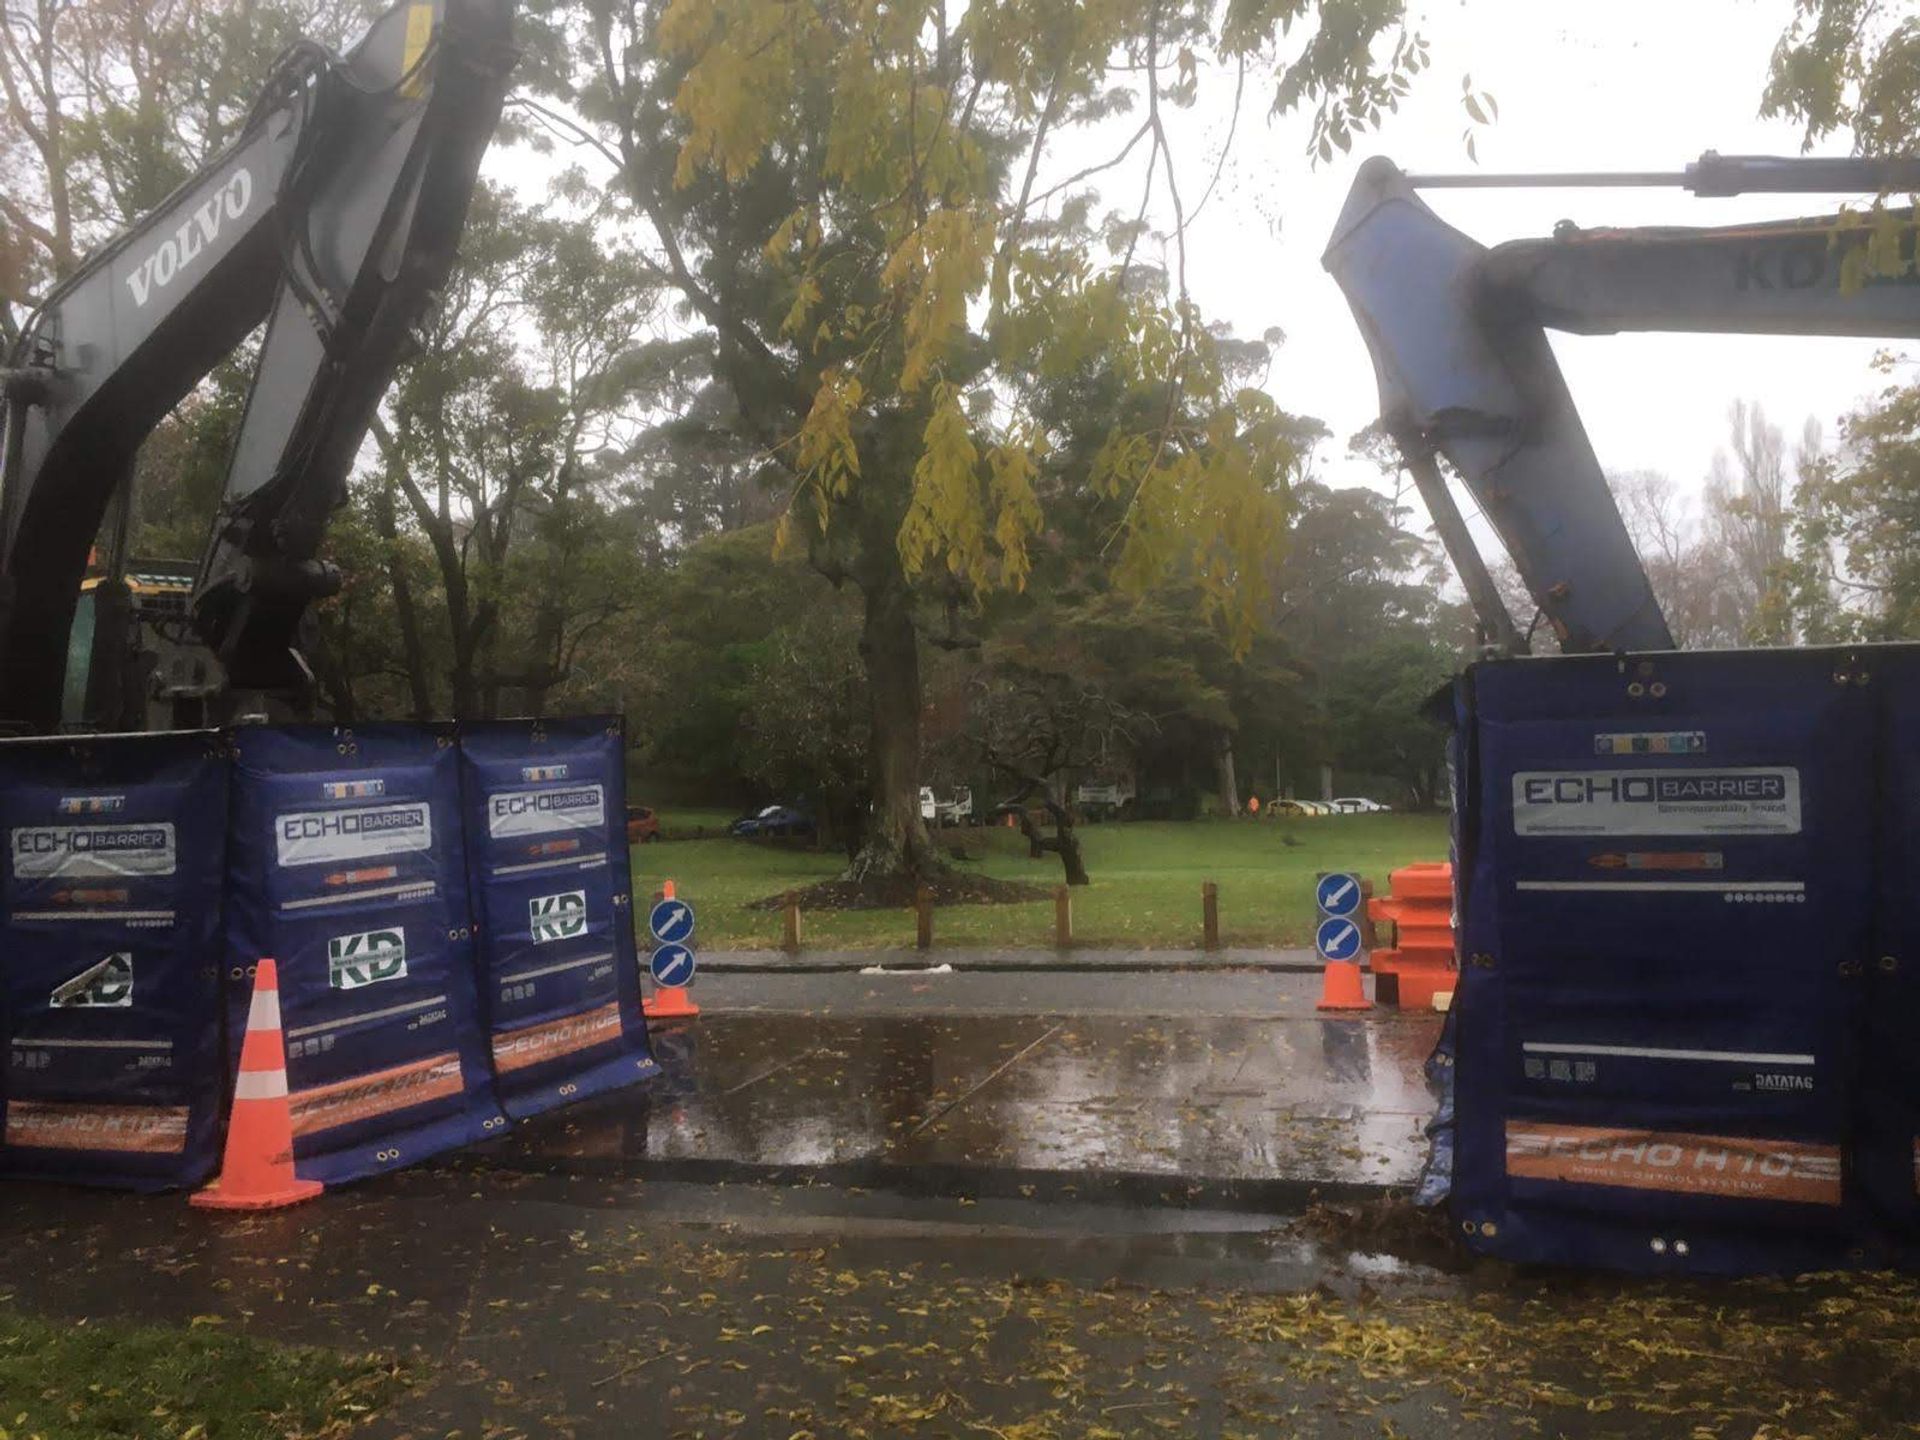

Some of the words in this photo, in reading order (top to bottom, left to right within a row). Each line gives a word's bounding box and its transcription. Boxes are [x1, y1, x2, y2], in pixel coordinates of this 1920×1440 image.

[126, 167, 252, 307] VOLVO
[496, 795, 551, 817] ECHO
[553, 792, 598, 807] BARRIER
[1525, 778, 1655, 804] ECHO
[1661, 778, 1780, 797] BARRIER
[284, 814, 360, 841] ECHO
[363, 811, 422, 829] BARRIER
[17, 832, 92, 854] ECHO
[95, 833, 163, 847] BARRIER
[531, 894, 585, 942] KD
[330, 931, 404, 987] KD
[1550, 1134, 1683, 1168] ECHO
